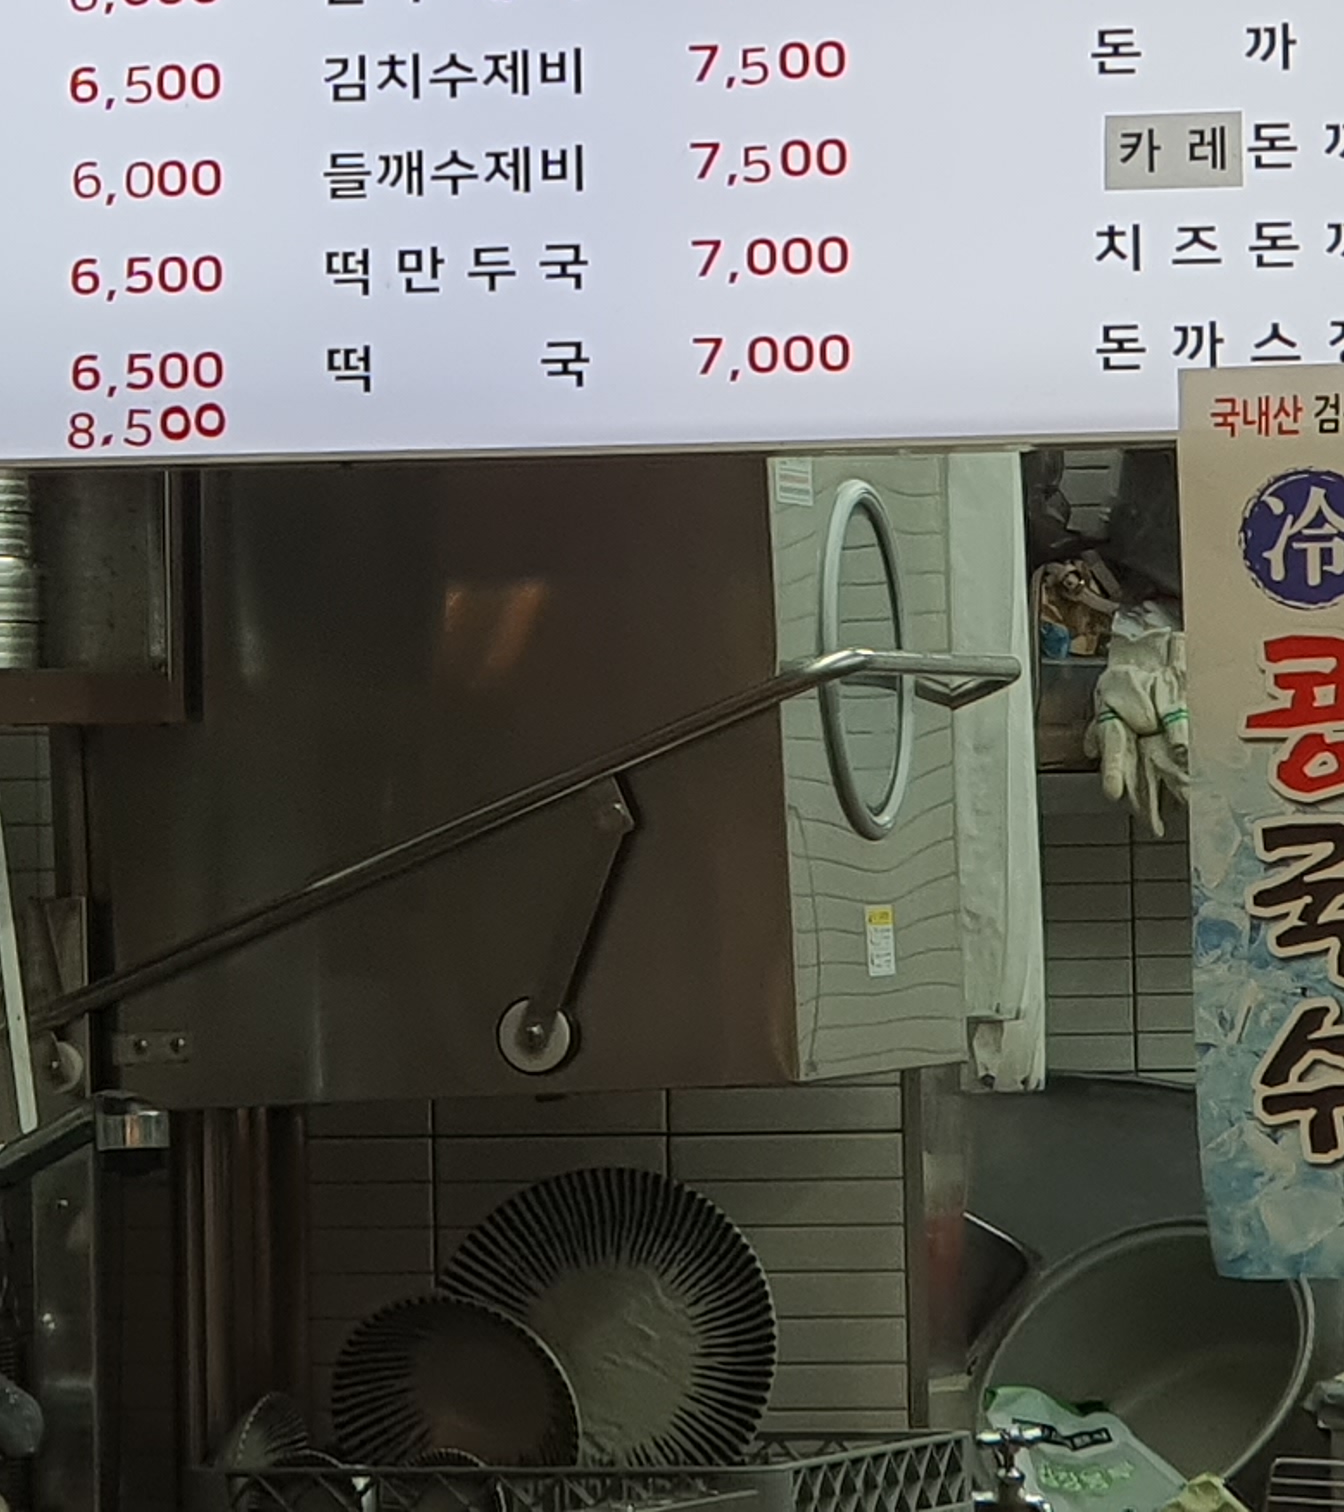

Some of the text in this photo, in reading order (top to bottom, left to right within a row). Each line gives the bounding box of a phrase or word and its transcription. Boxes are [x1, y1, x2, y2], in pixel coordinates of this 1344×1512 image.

[70, 63, 220, 110] 6,500
[324, 41, 845, 102] 김치수제비 7,500
[74, 160, 221, 205] 6,000
[323, 139, 847, 199] 들깨수제비 7,500
[71, 255, 222, 302] 6,500
[691, 236, 848, 284] 7,000
[72, 352, 223, 397] 6,500
[693, 334, 850, 381] 7,000
[1210, 394, 1303, 436] 국내산
